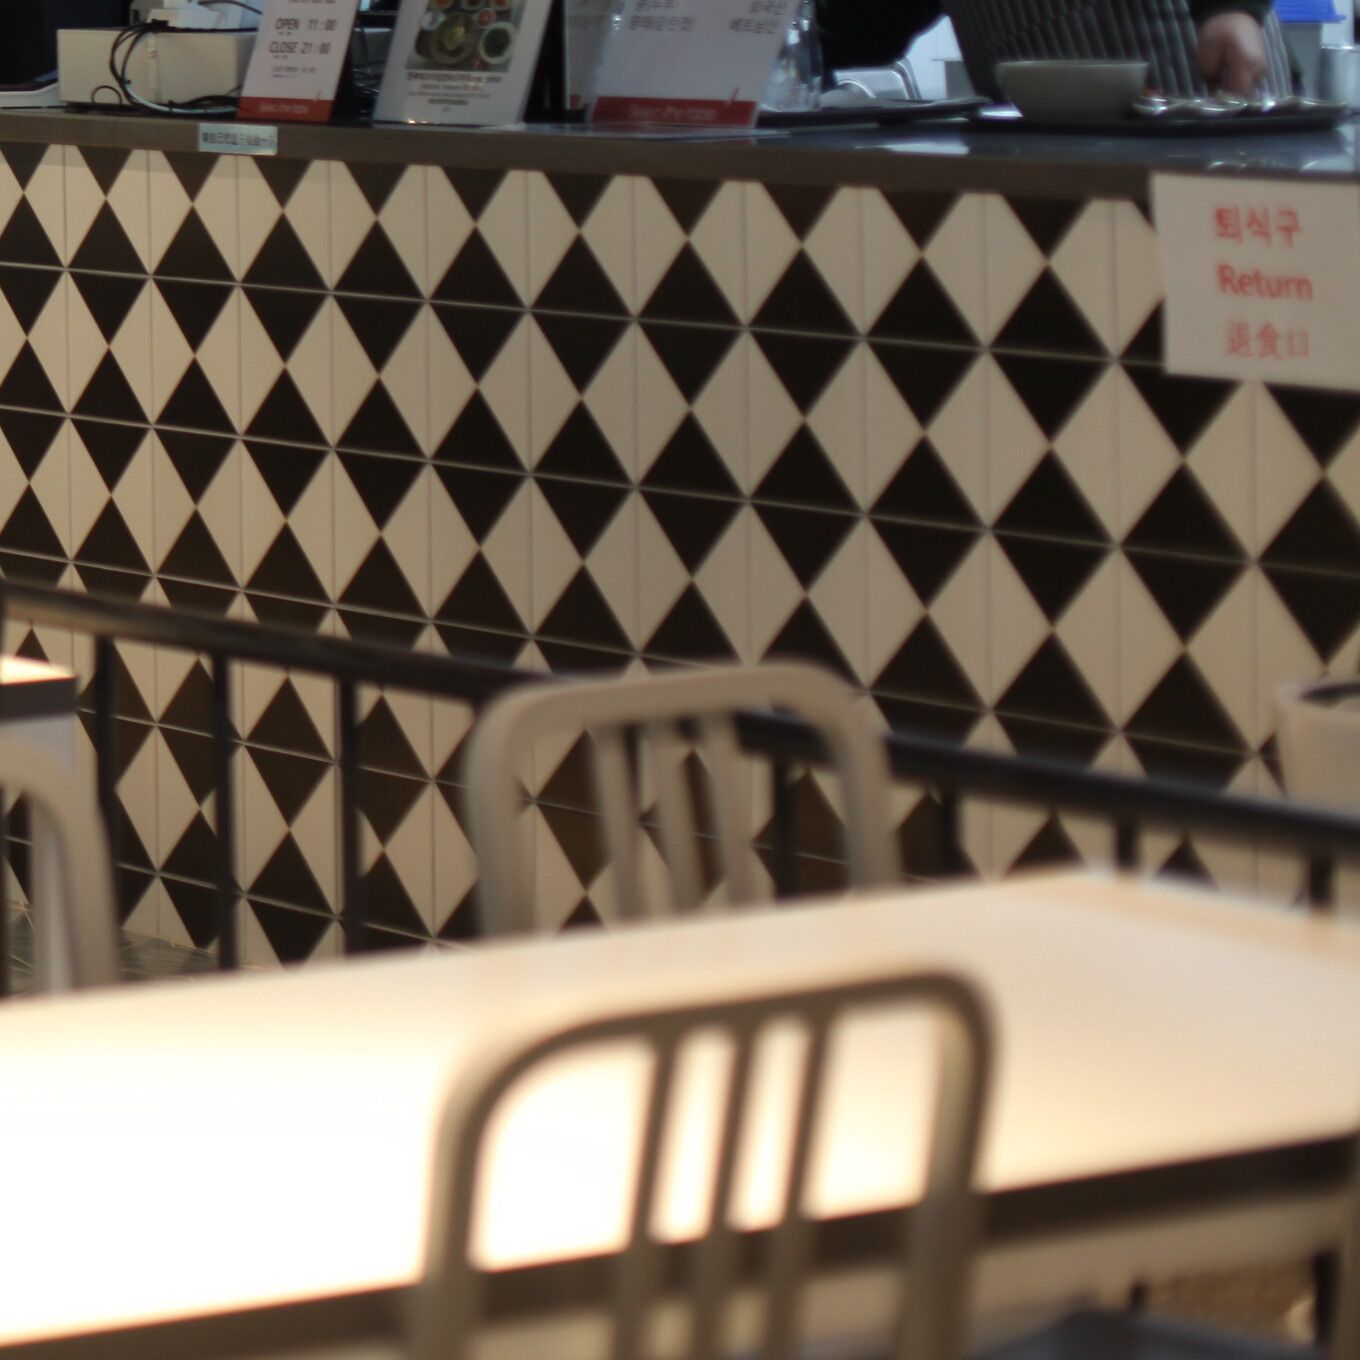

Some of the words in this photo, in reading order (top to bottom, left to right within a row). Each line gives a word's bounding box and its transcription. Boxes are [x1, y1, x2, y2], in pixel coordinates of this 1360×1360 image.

[275, 18, 300, 30] OPEN
[269, 40, 298, 54] CLOSE
[1213, 205, 1303, 248] 퇴식구
[1215, 262, 1314, 303] Return
